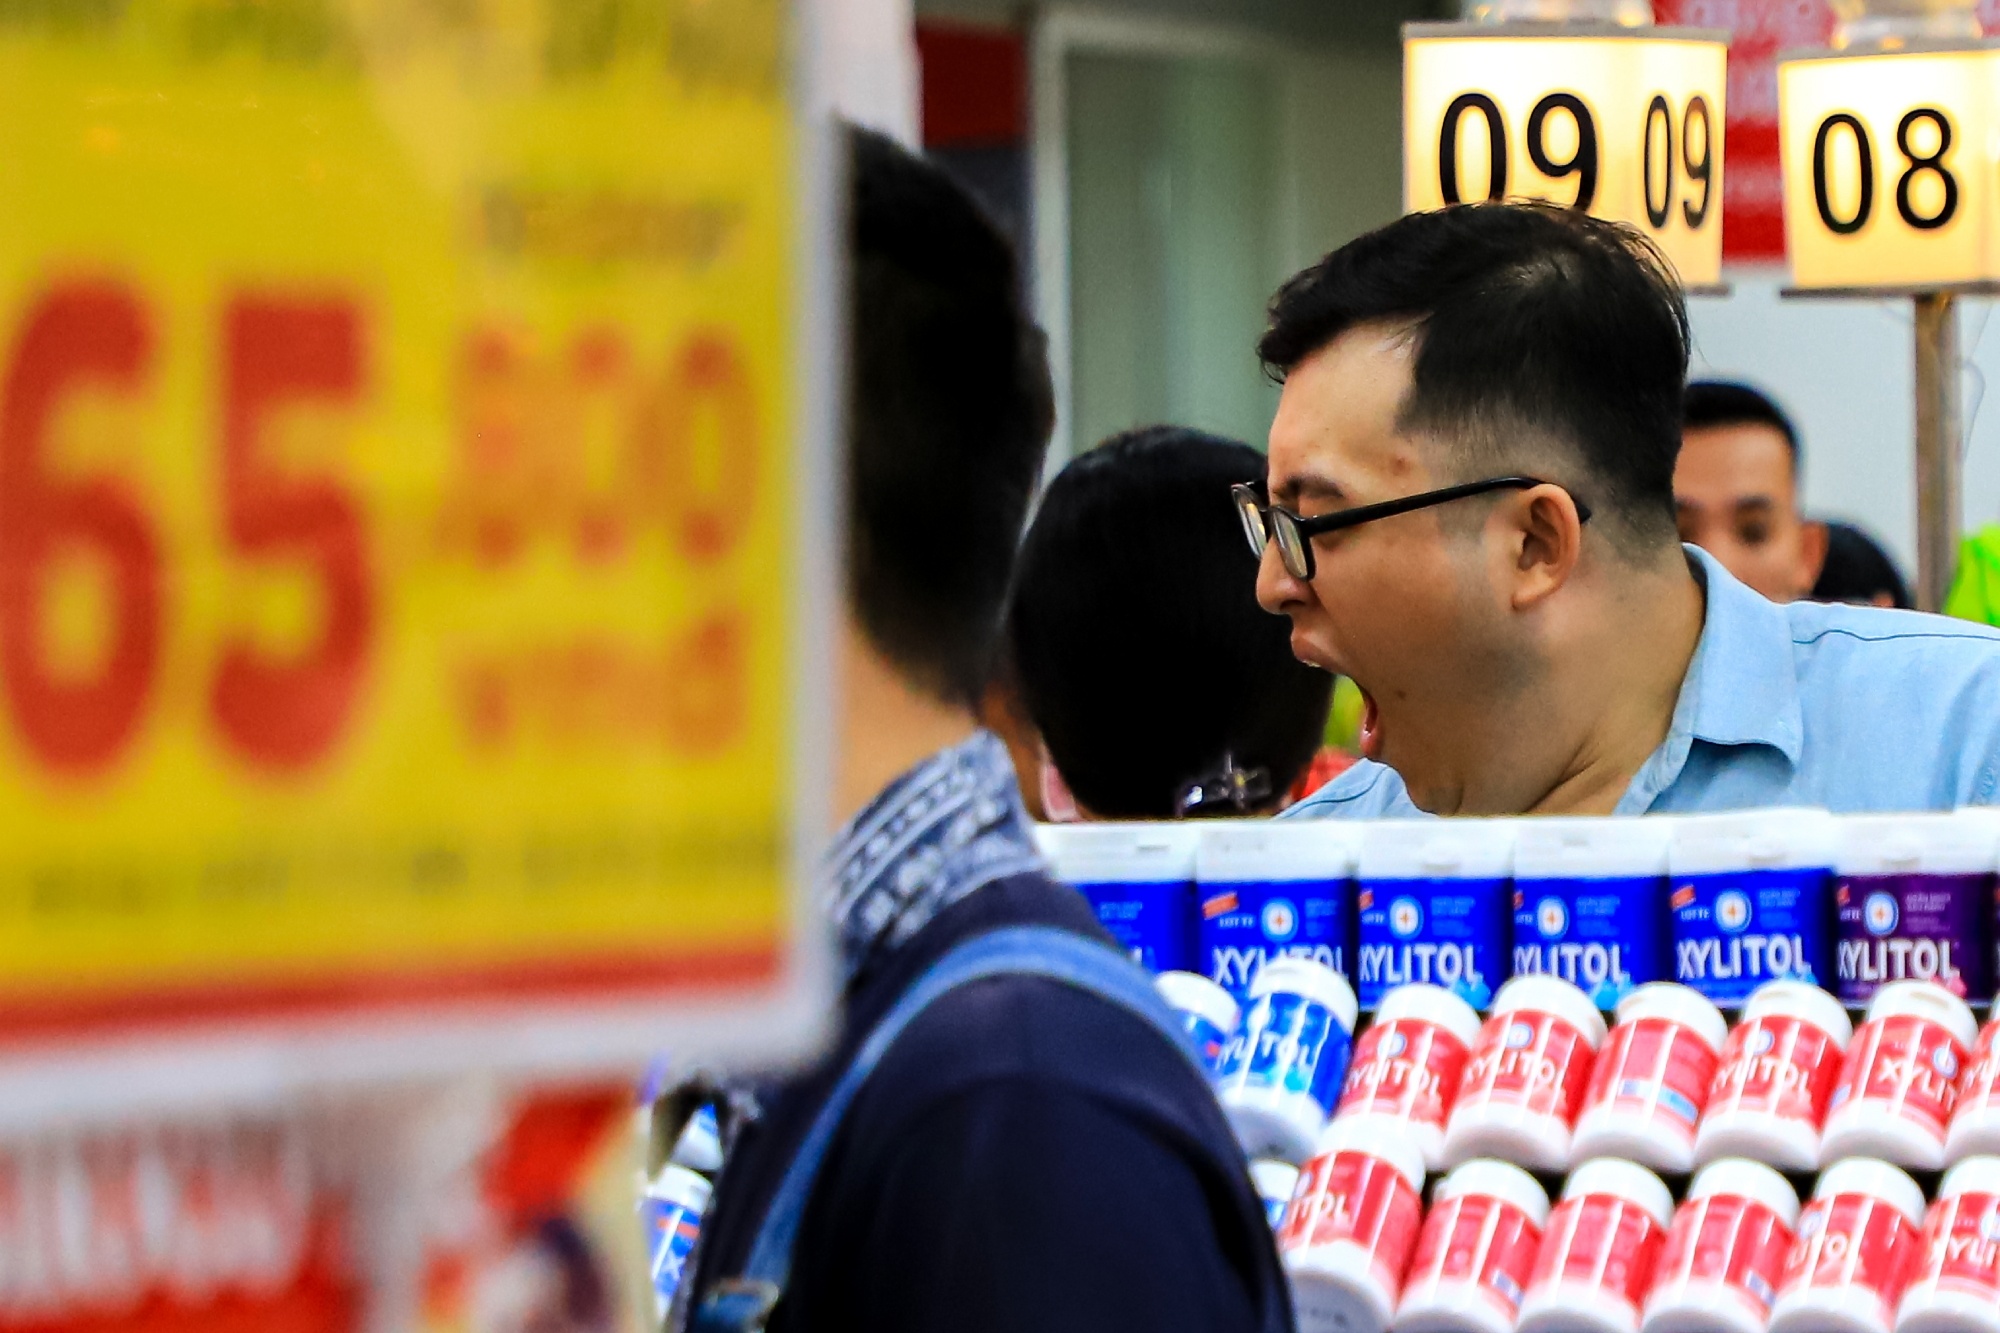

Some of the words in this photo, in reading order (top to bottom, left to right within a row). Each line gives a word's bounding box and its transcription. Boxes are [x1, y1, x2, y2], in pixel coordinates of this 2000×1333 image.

[1439, 93, 1599, 213] 09
[1644, 95, 1711, 229] 09
[1813, 108, 1958, 234] 08
[2, 275, 378, 780] 65
[1678, 934, 1812, 979] XYLITOL
[1839, 939, 1961, 981] XYLITOL
